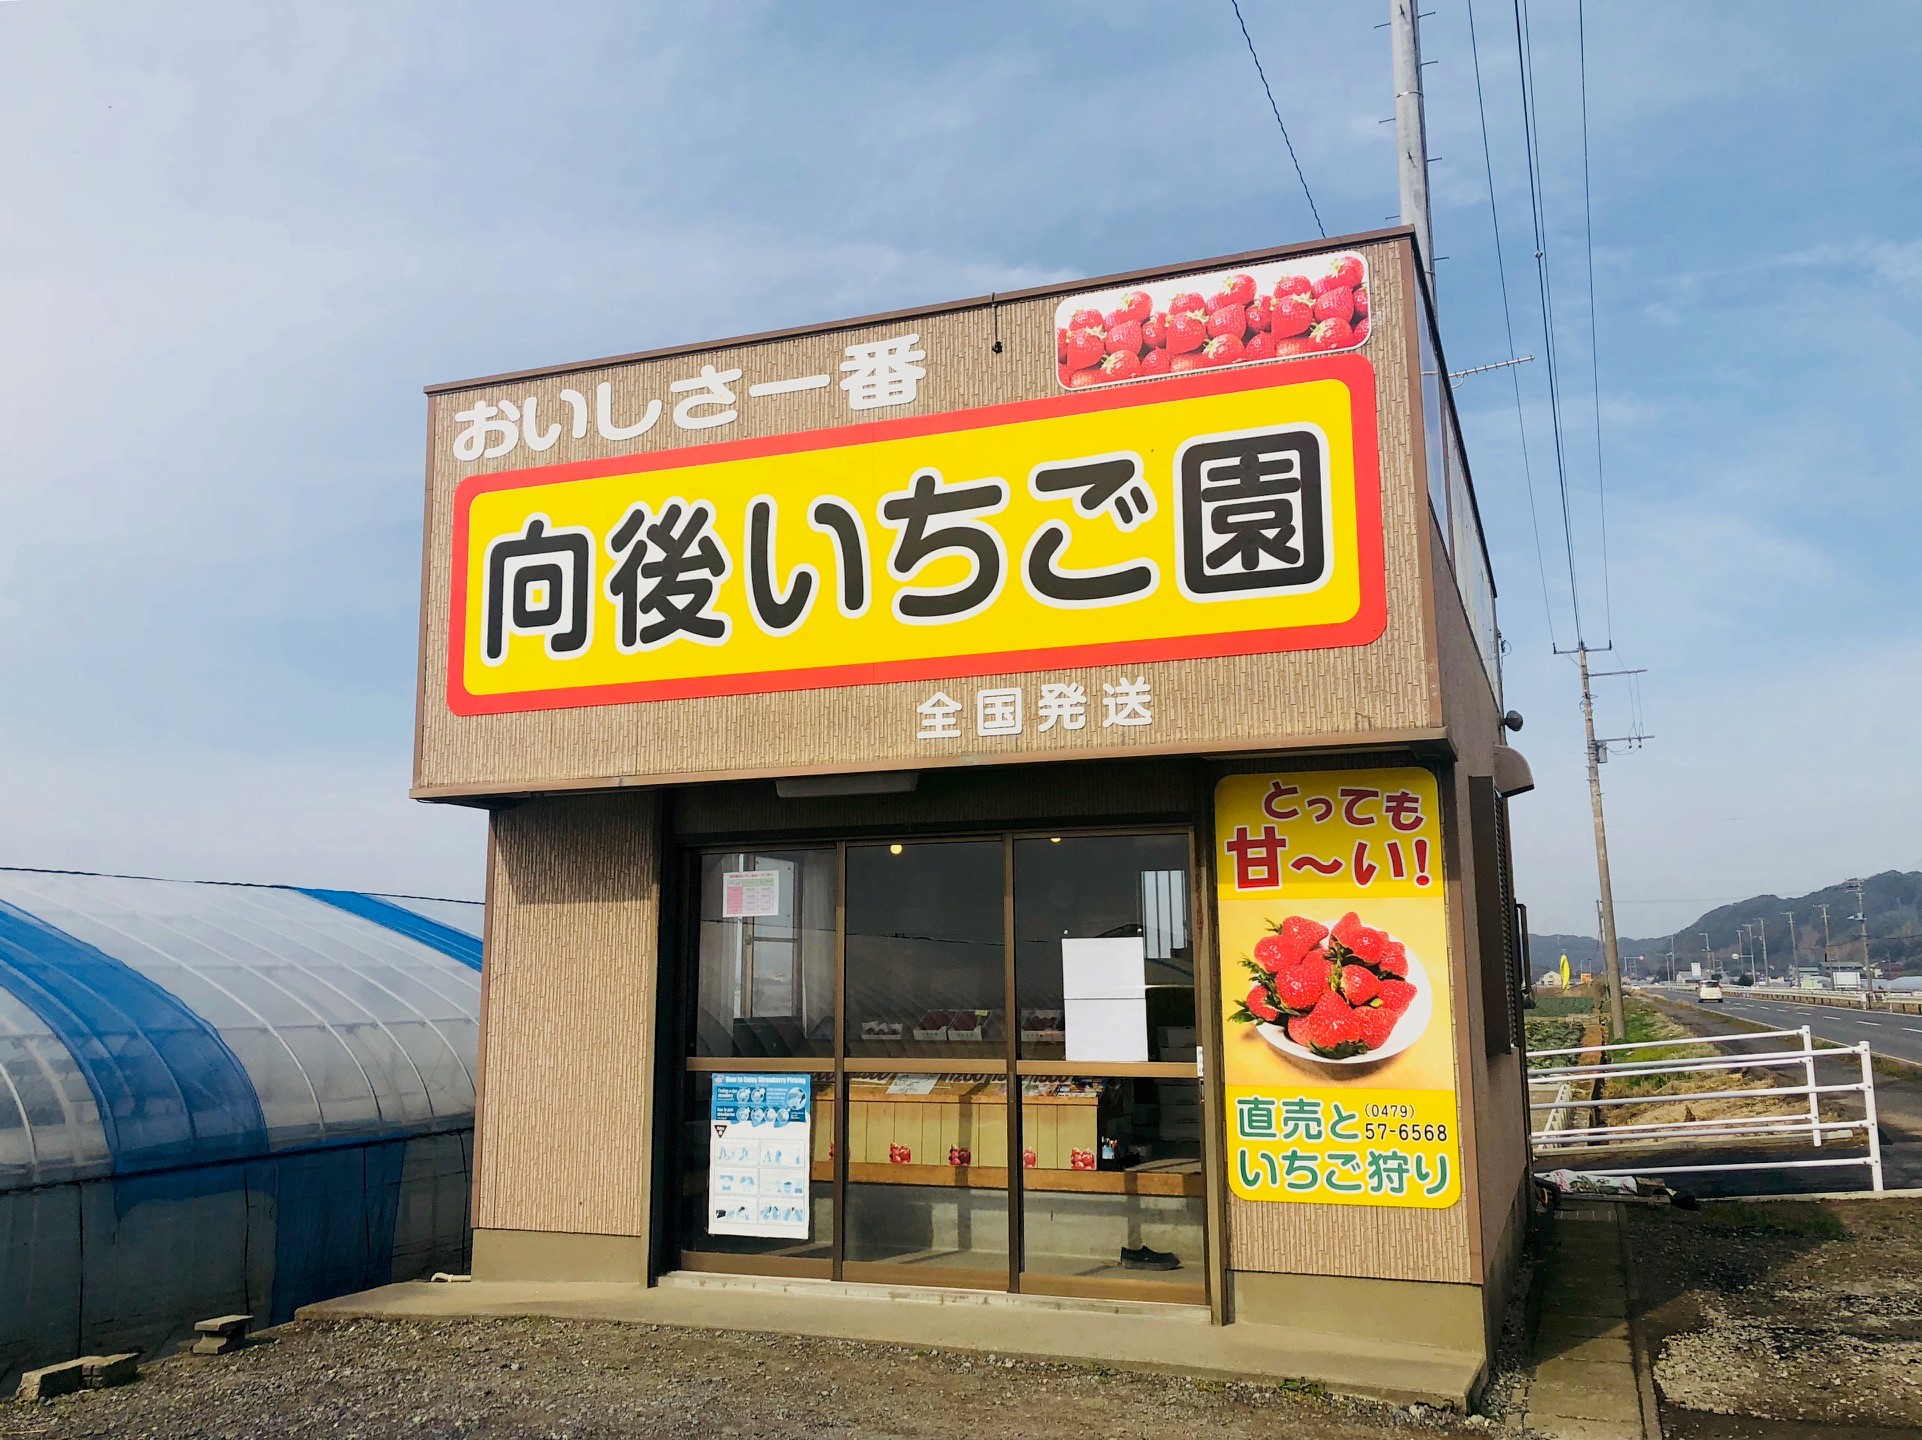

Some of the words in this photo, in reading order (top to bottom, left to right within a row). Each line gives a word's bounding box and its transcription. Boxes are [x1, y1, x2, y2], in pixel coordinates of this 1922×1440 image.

[453, 334, 926, 461] おいしさ一番
[484, 426, 1330, 662] 向後いちご園
[916, 675, 1152, 739] 全国発送
[1262, 780, 1425, 832] とっても
[743, 1076, 758, 1084] Enjoy
[758, 1076, 787, 1084] Strawberry
[1237, 1097, 1360, 1141] 直売と
[1364, 1103, 1416, 1119] (0479)
[1365, 1122, 1448, 1142] 57-6568
[1239, 1149, 1448, 1196] いちご狩り
